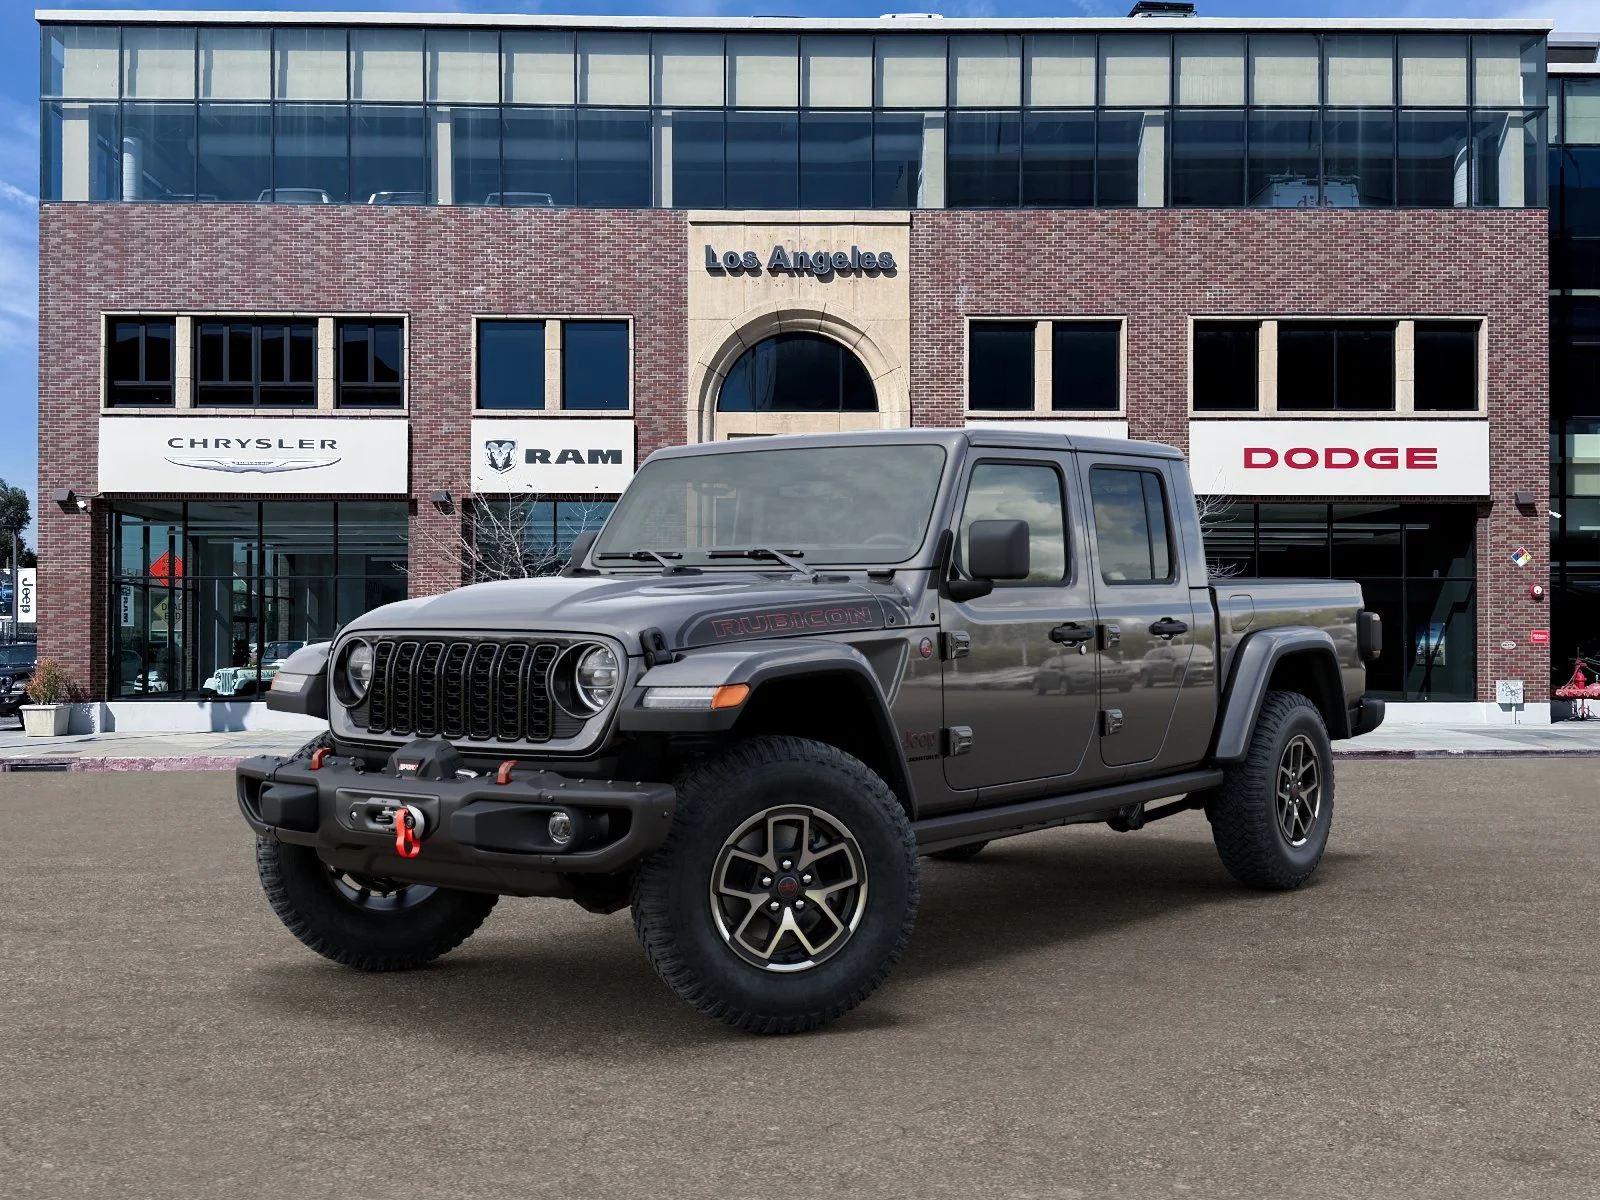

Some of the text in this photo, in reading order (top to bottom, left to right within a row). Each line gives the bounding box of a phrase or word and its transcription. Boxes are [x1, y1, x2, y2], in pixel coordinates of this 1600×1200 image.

[704, 244, 894, 275] Los Angeles
[167, 437, 338, 449] CHRYSLER
[525, 448, 623, 464] RAM
[1244, 447, 1438, 469] DODGE
[20, 577, 34, 613] Jeep
[165, 612, 181, 620] ED
[712, 606, 873, 638] RUBICON
[904, 729, 936, 749] Jeep
